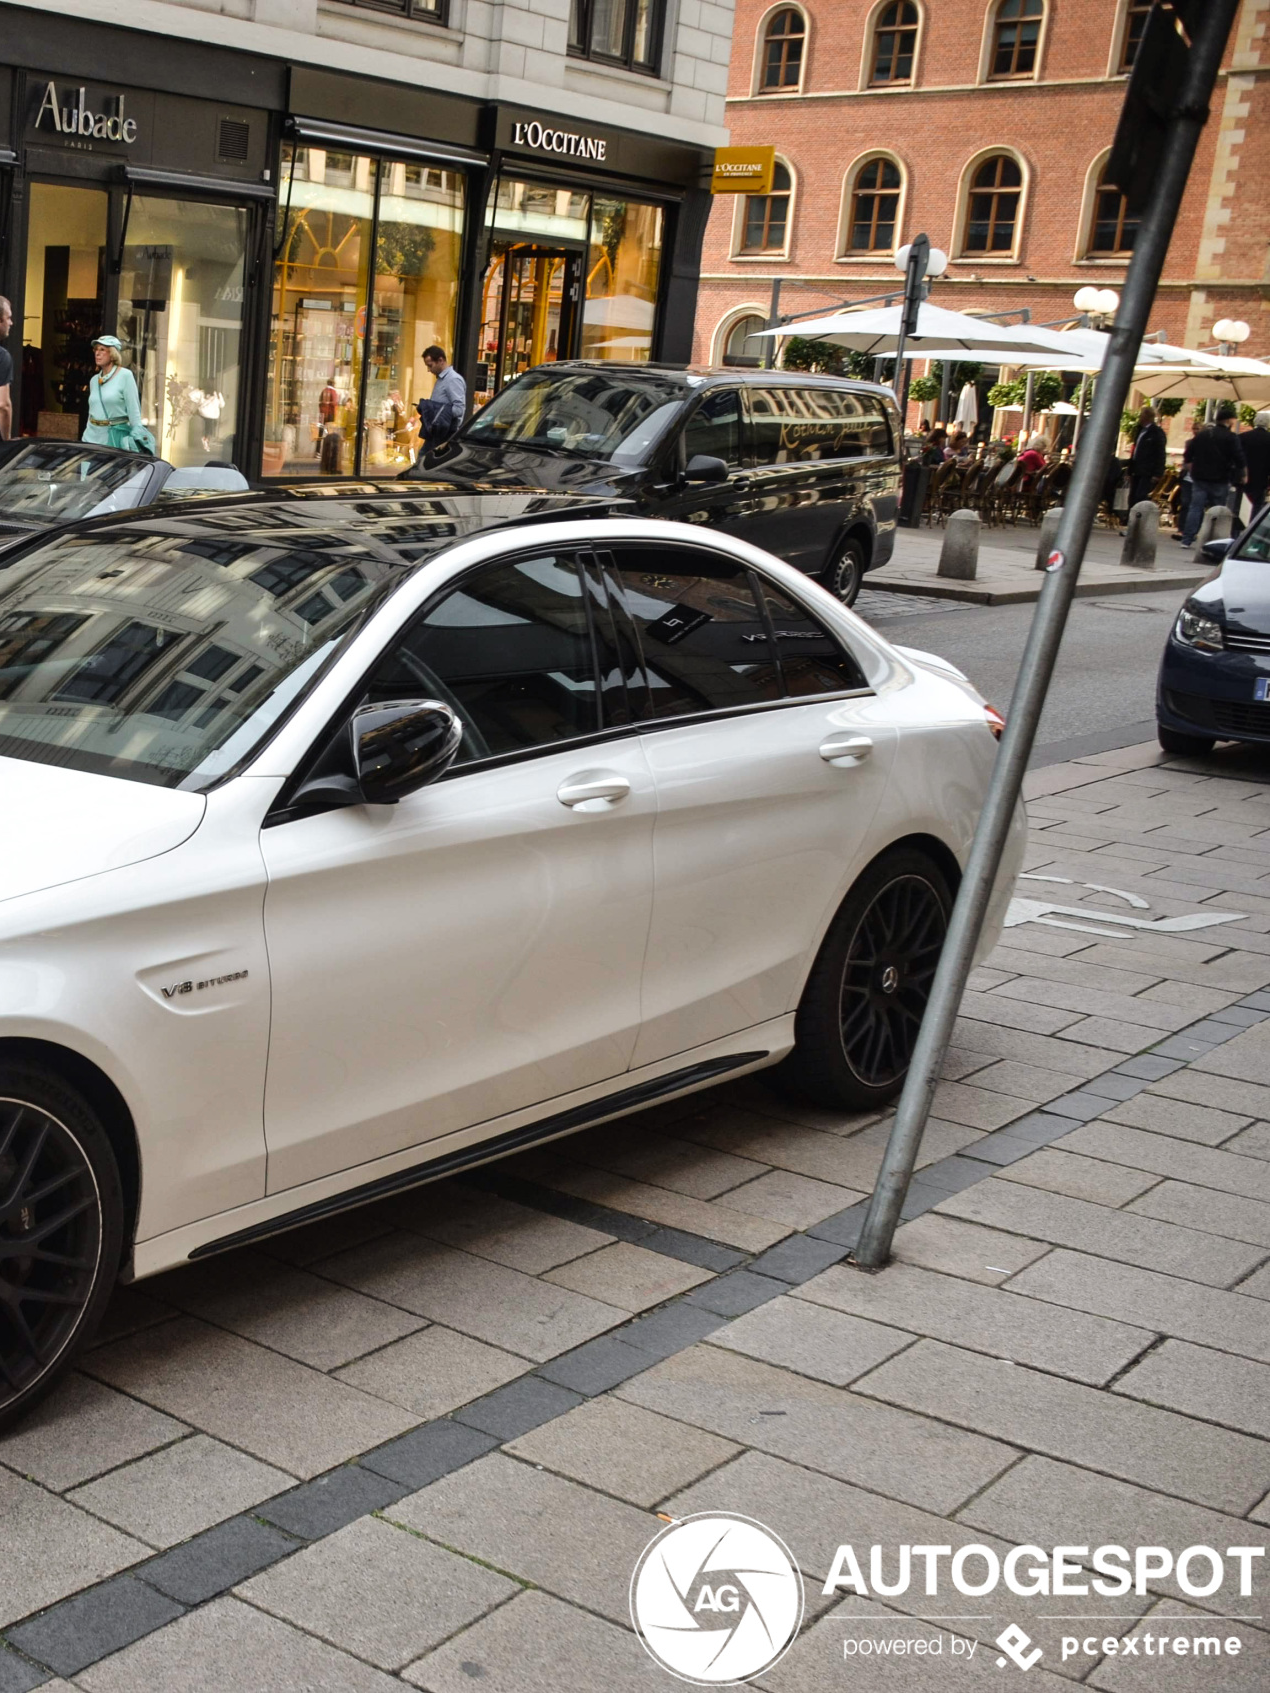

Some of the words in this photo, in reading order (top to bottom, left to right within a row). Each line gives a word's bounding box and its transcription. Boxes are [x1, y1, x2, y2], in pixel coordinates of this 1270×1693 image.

[34, 81, 138, 144] Aubade
[64, 140, 94, 151] PARIS
[514, 121, 607, 161] L'OCCITANE
[715, 163, 763, 172] L'OCCITANE
[160, 979, 193, 999] V8
[196, 969, 249, 990] BITURBO
